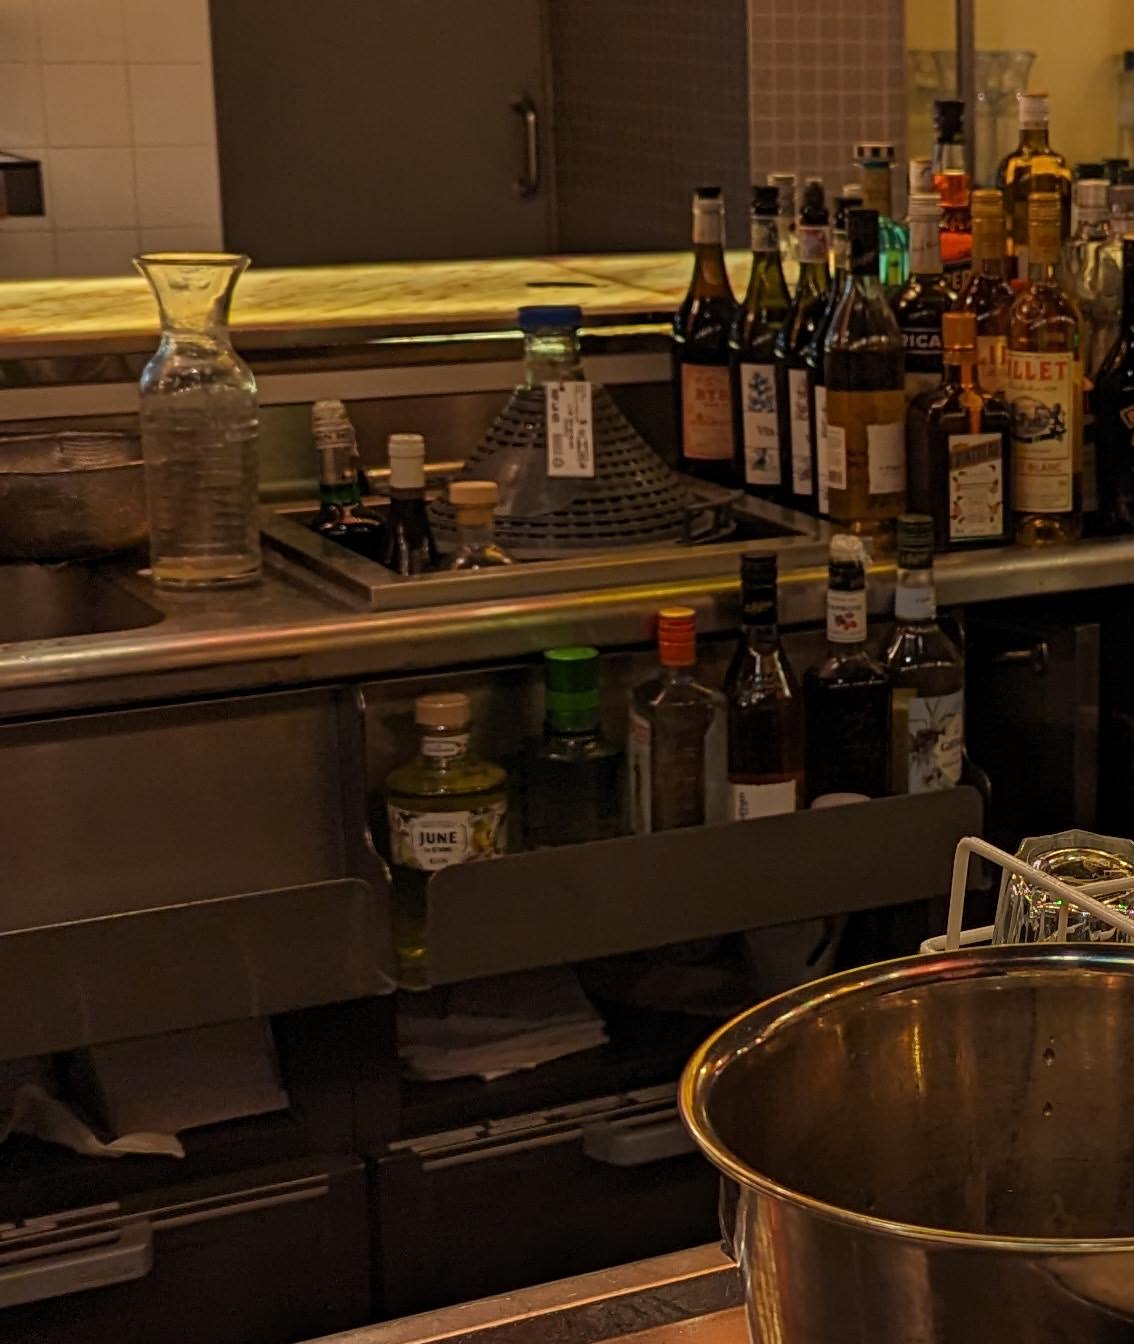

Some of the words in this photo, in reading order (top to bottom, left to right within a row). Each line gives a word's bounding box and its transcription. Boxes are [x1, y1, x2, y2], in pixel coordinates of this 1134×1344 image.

[903, 333, 941, 348] RICA
[1008, 360, 1068, 382] ILLET
[419, 831, 457, 846] JUNE
